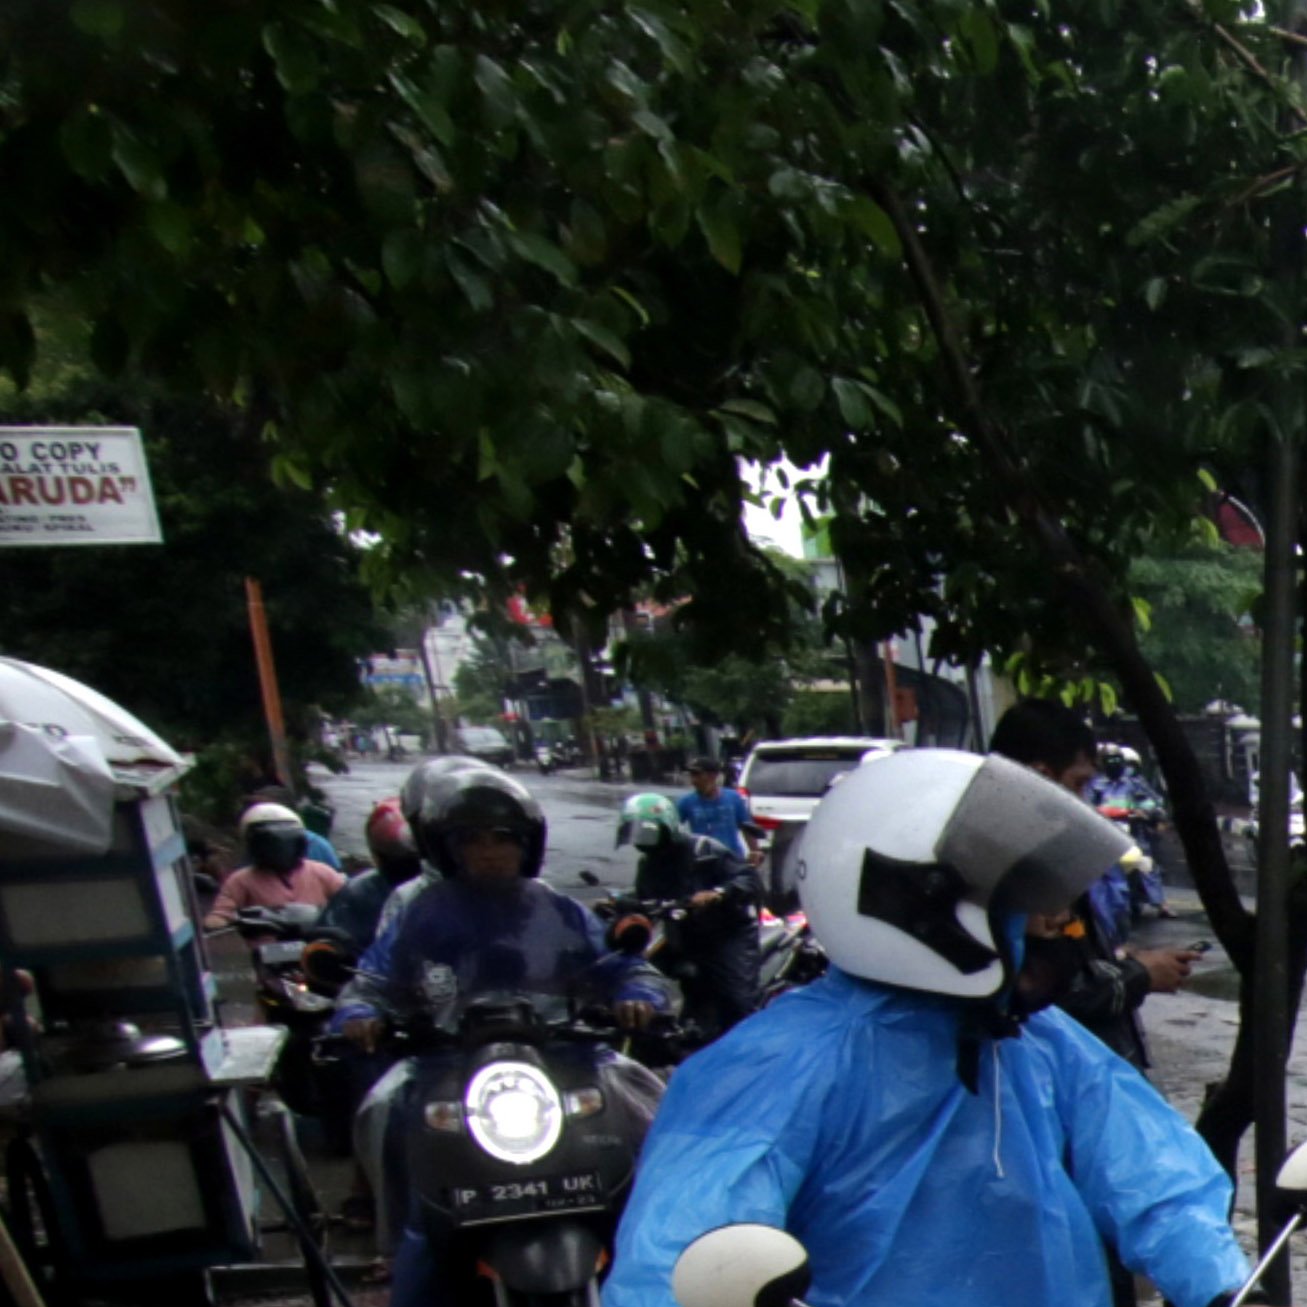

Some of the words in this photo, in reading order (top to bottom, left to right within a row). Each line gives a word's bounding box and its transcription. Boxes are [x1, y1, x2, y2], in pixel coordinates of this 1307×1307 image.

[31, 441, 100, 461] COPY
[1, 463, 52, 474] ALAT
[61, 462, 121, 474] TULIS
[461, 1188, 477, 1204] P
[491, 1181, 549, 1201] 2341
[562, 1174, 594, 1191] UK
